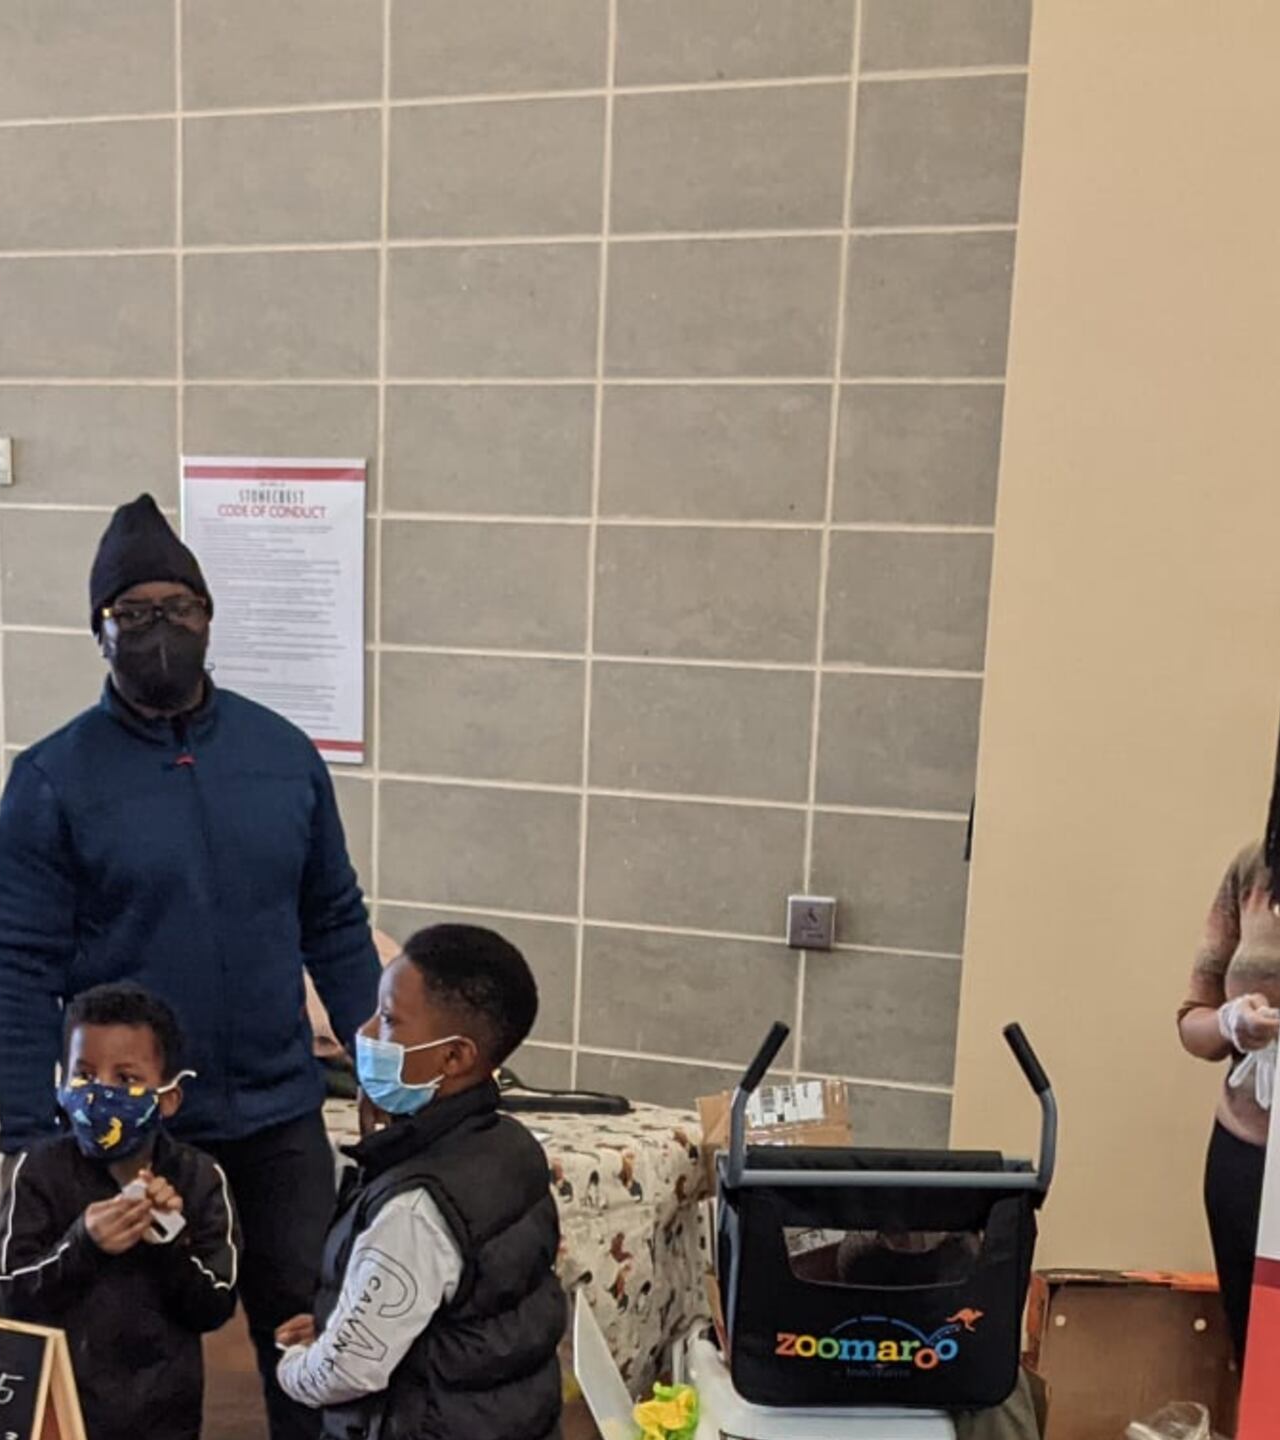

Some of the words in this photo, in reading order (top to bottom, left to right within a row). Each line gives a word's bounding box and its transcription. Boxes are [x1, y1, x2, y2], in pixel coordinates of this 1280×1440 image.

[239, 489, 304, 503] STONECREST
[218, 504, 248, 517] CODE
[251, 505, 265, 517] OF
[269, 505, 327, 519] CONDUCT
[775, 1331, 959, 1369] zoomaroo
